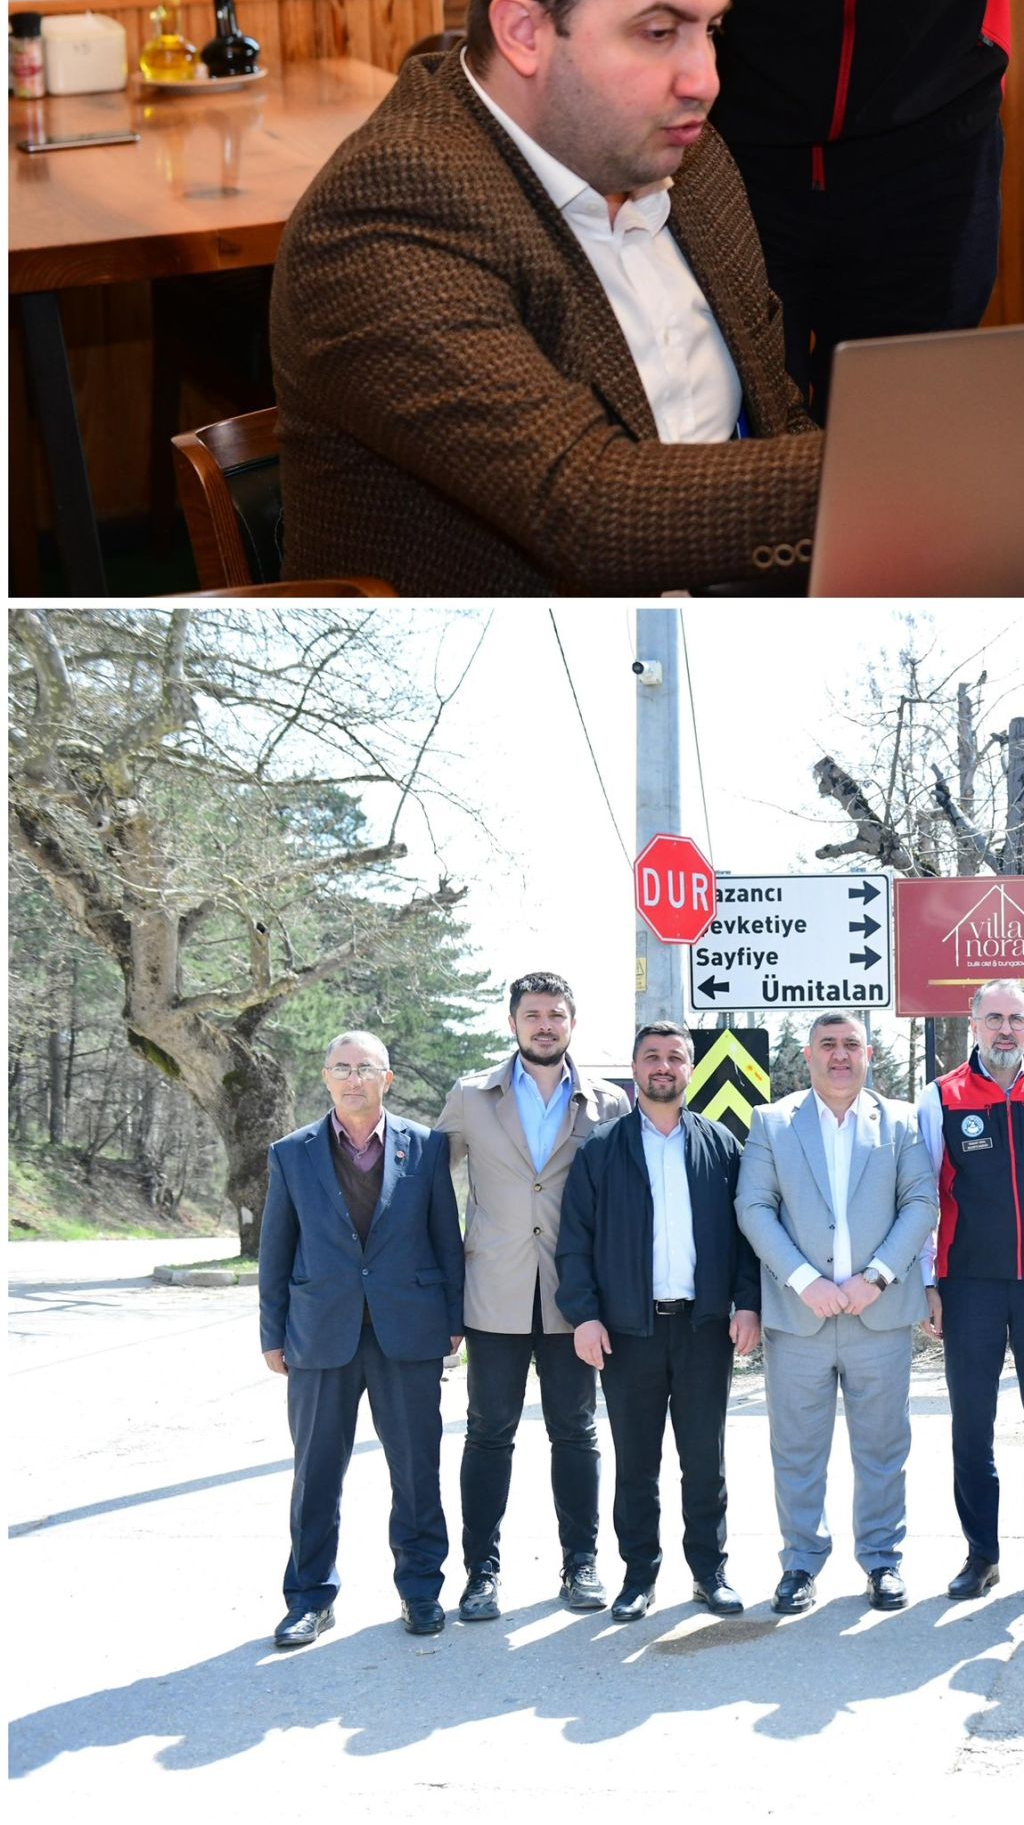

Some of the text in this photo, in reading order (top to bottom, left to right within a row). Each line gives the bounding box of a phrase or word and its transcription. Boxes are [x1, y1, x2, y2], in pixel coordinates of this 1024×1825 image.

[642, 867, 709, 912] DUR
[716, 887, 783, 903] azancı
[703, 916, 807, 938] evketiye
[969, 907, 1023, 939] villa
[696, 948, 779, 971] Sayfiye
[762, 974, 883, 1002] Ümitalan
